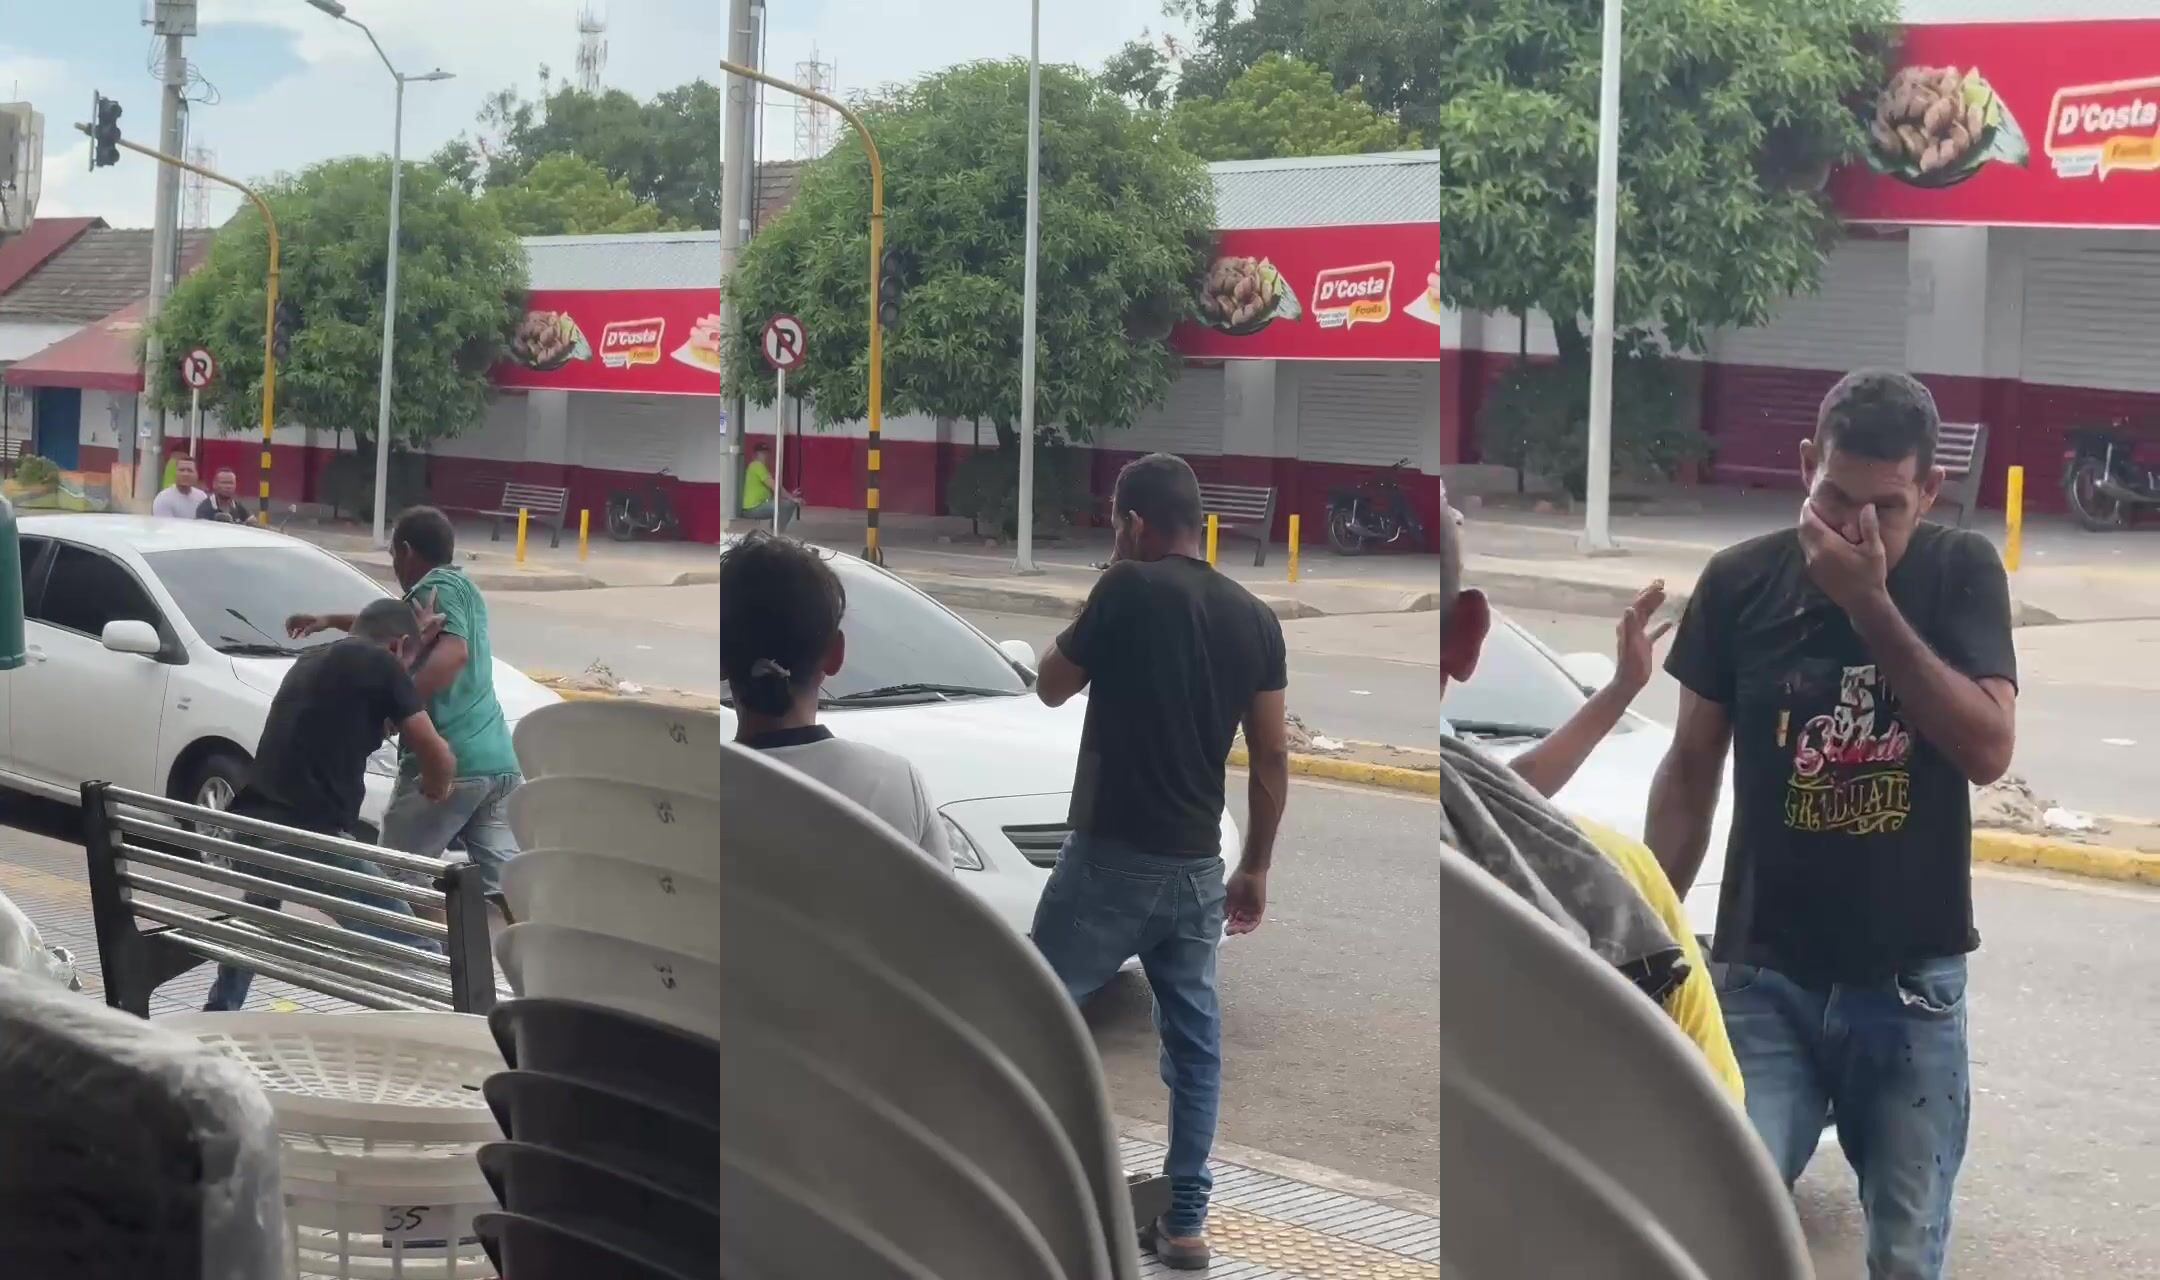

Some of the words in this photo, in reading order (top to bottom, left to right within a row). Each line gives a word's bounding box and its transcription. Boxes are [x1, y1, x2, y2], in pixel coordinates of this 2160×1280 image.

[2057, 98, 2158, 135] D'Costa
[1320, 276, 1385, 300] D'Costa
[606, 328, 657, 346] D'Costa
[384, 1206, 430, 1231] 35
